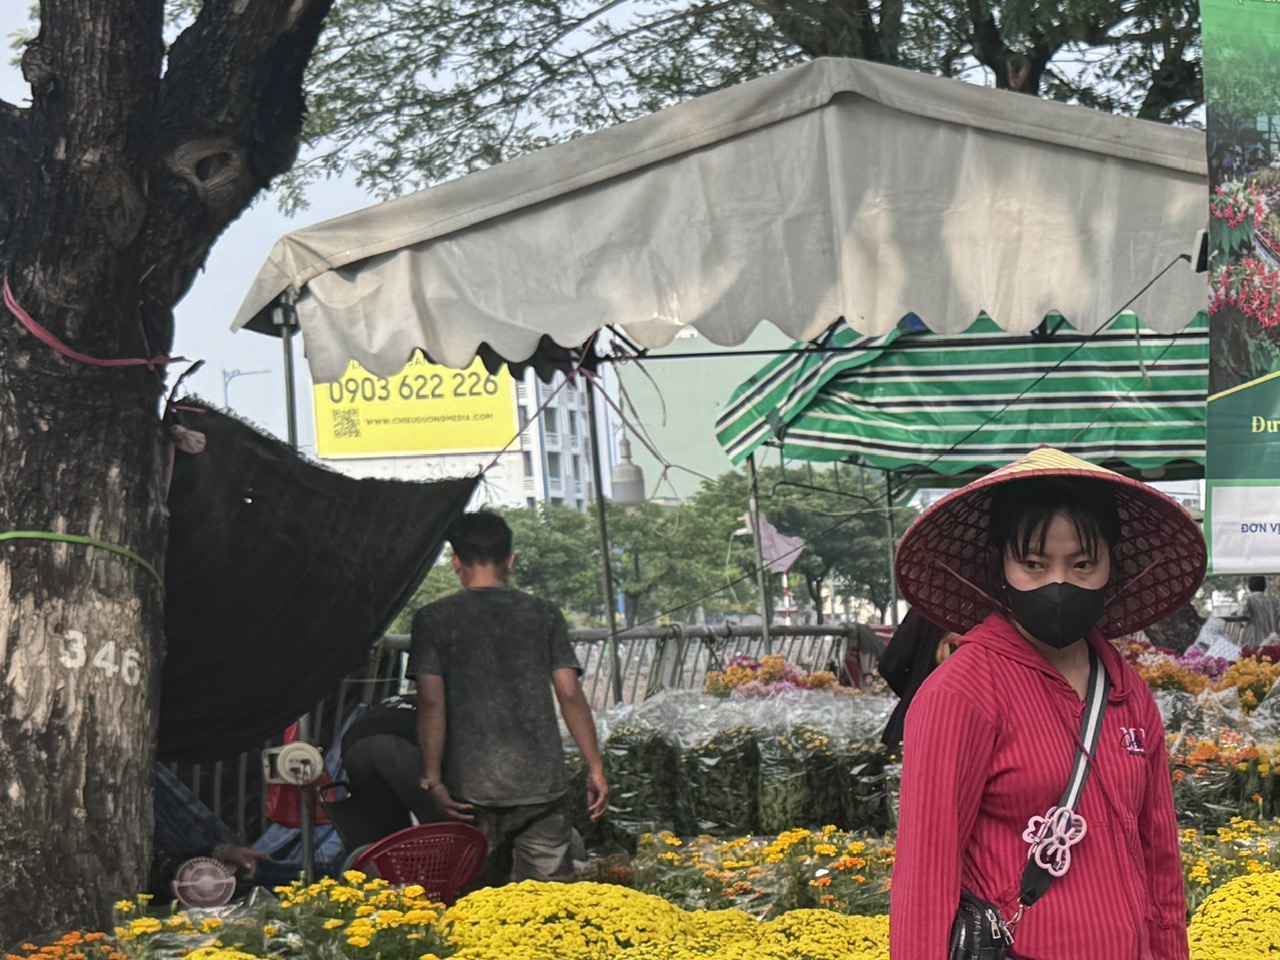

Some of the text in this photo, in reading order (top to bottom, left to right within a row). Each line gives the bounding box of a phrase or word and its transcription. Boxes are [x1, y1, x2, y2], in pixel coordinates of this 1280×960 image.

[329, 371, 498, 403] 0903 622 226
[1241, 522, 1267, 533] ĐƠN
[60, 629, 142, 687] 346
